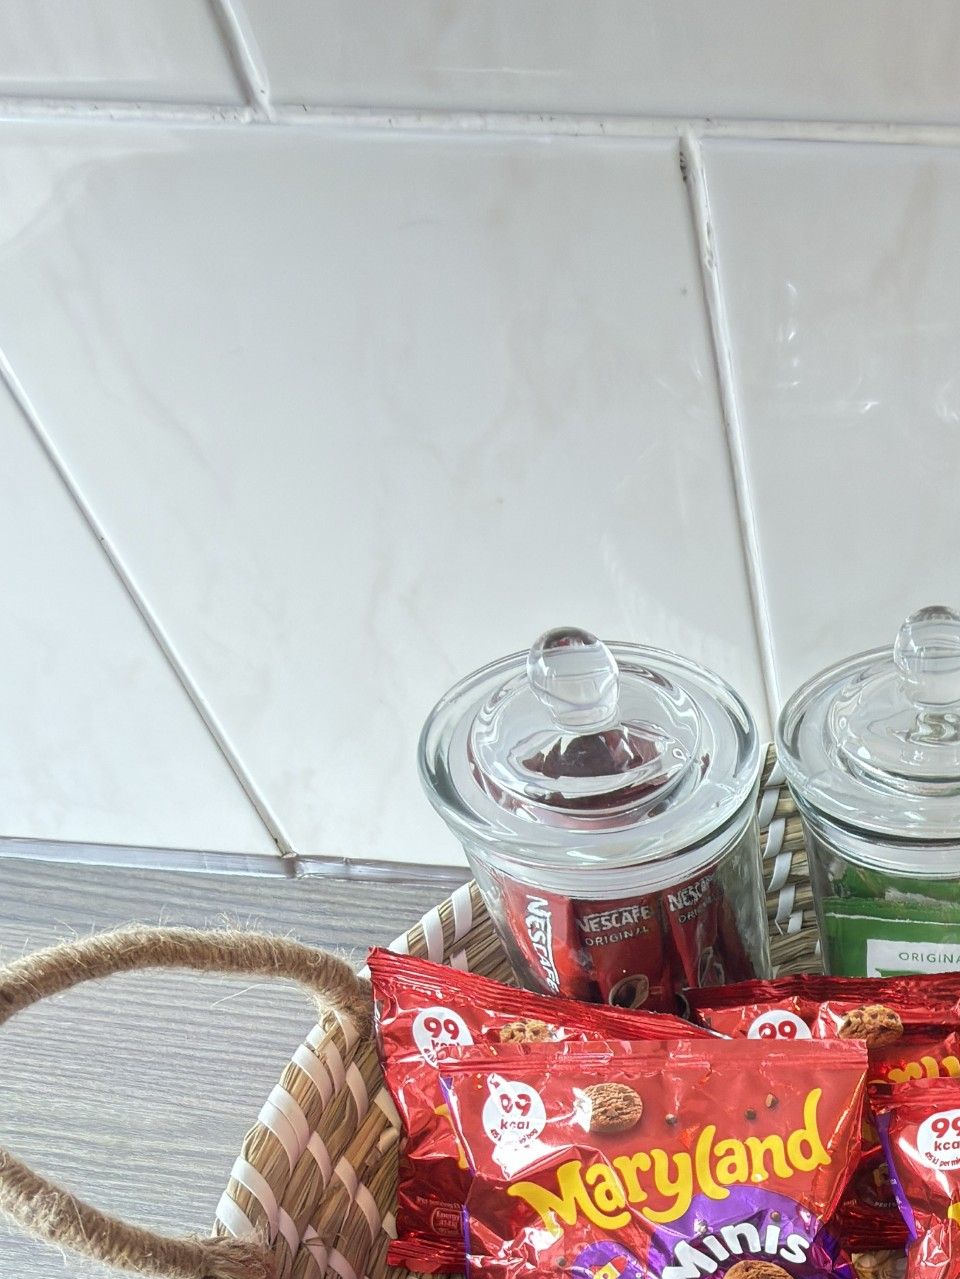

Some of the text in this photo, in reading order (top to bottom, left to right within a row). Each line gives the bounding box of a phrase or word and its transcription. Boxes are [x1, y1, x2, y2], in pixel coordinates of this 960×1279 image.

[585, 926, 649, 946] ORIGINAL
[423, 1017, 460, 1040] 99
[508, 1087, 831, 1238] Maryland
